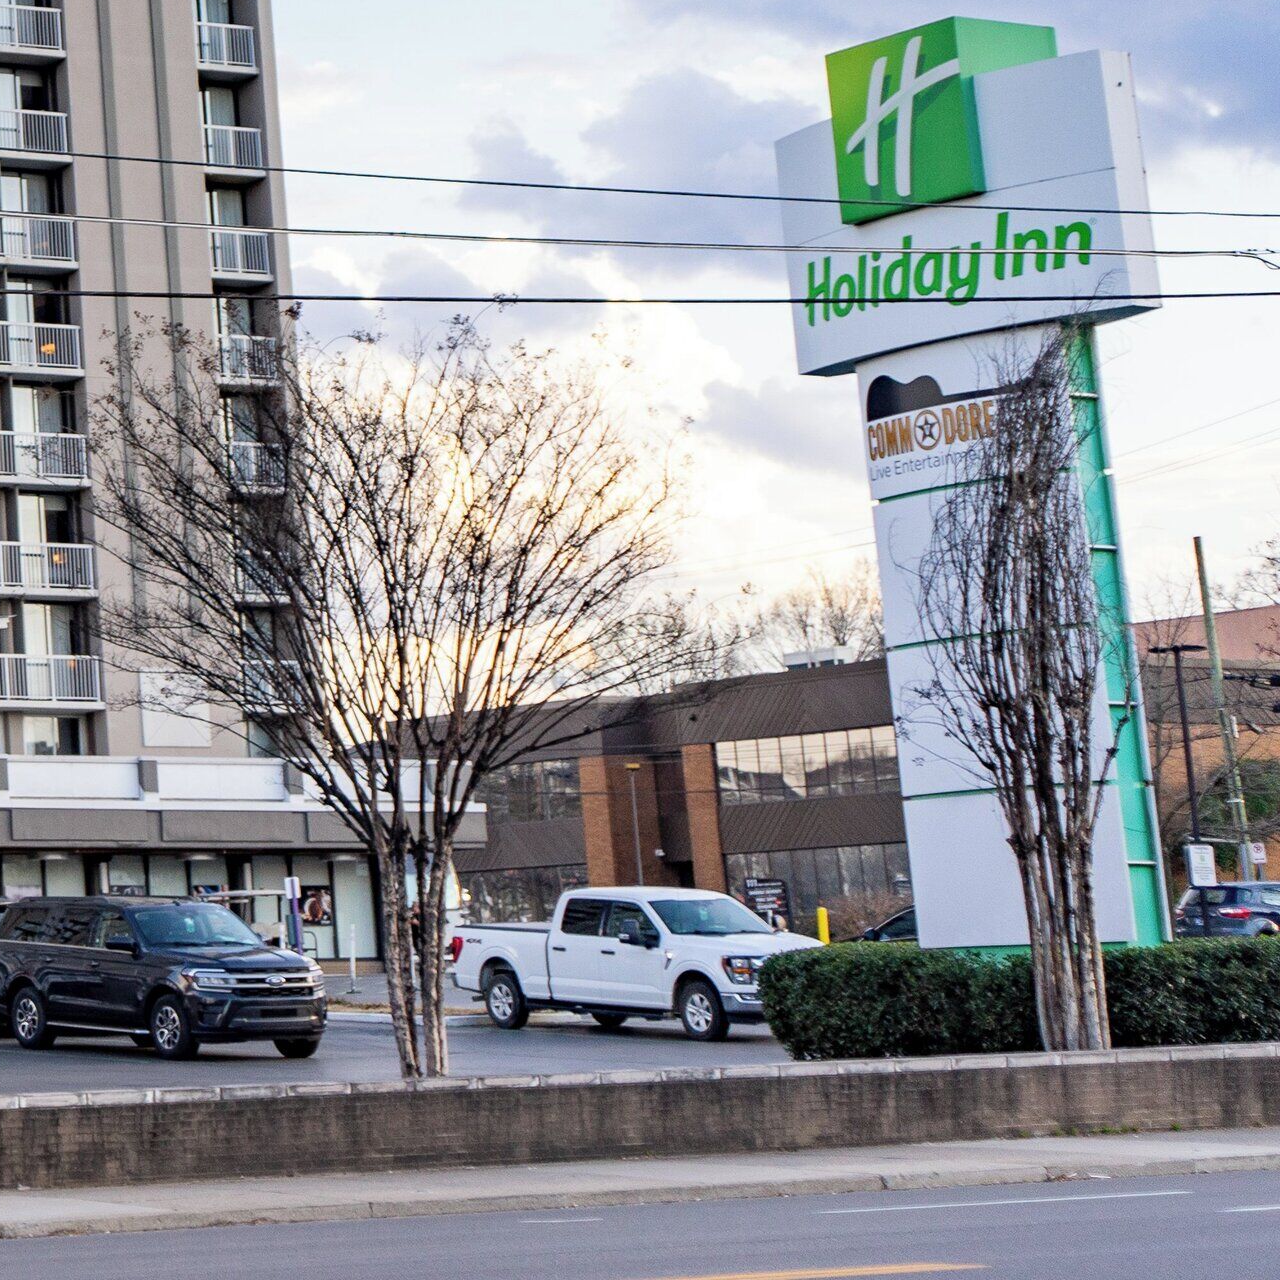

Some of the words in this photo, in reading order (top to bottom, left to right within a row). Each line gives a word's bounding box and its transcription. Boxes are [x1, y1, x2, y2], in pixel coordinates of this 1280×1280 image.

[805, 235, 981, 327] Holiday
[994, 211, 1092, 280] Inn
[870, 465, 891, 481] Live
